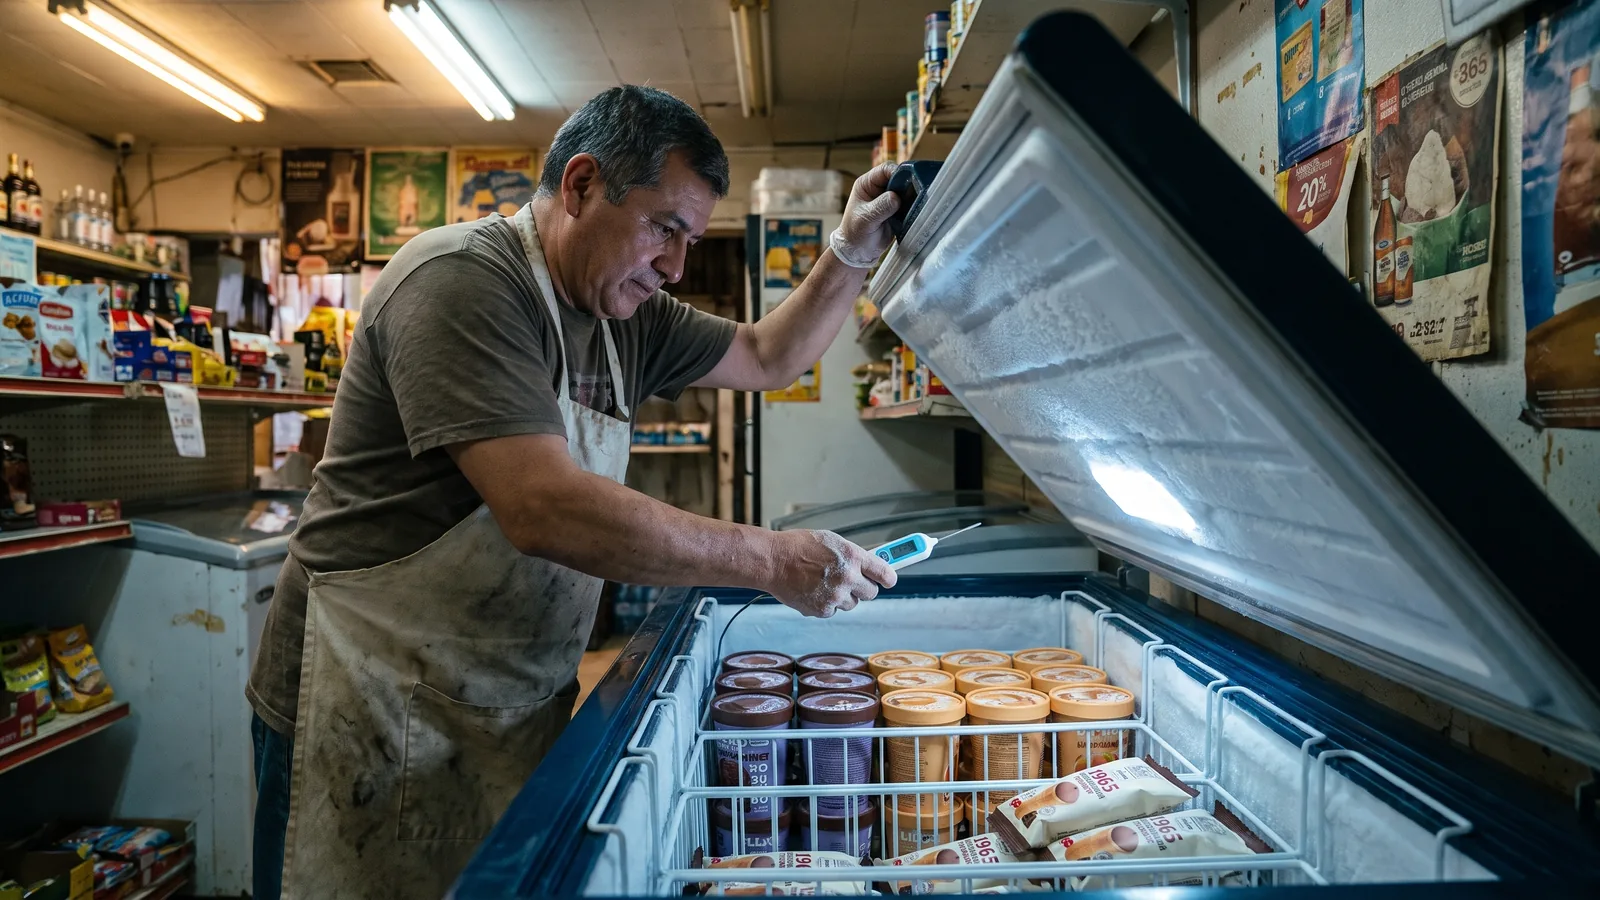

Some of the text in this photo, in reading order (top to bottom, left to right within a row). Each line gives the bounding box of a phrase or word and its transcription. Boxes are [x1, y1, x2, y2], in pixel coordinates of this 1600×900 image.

[1458, 52, 1488, 85] 365
[1296, 173, 1328, 213] 20%
[1088, 769, 1119, 793] 1965
[1150, 816, 1183, 844] 1965
[973, 836, 1000, 864] 1965
